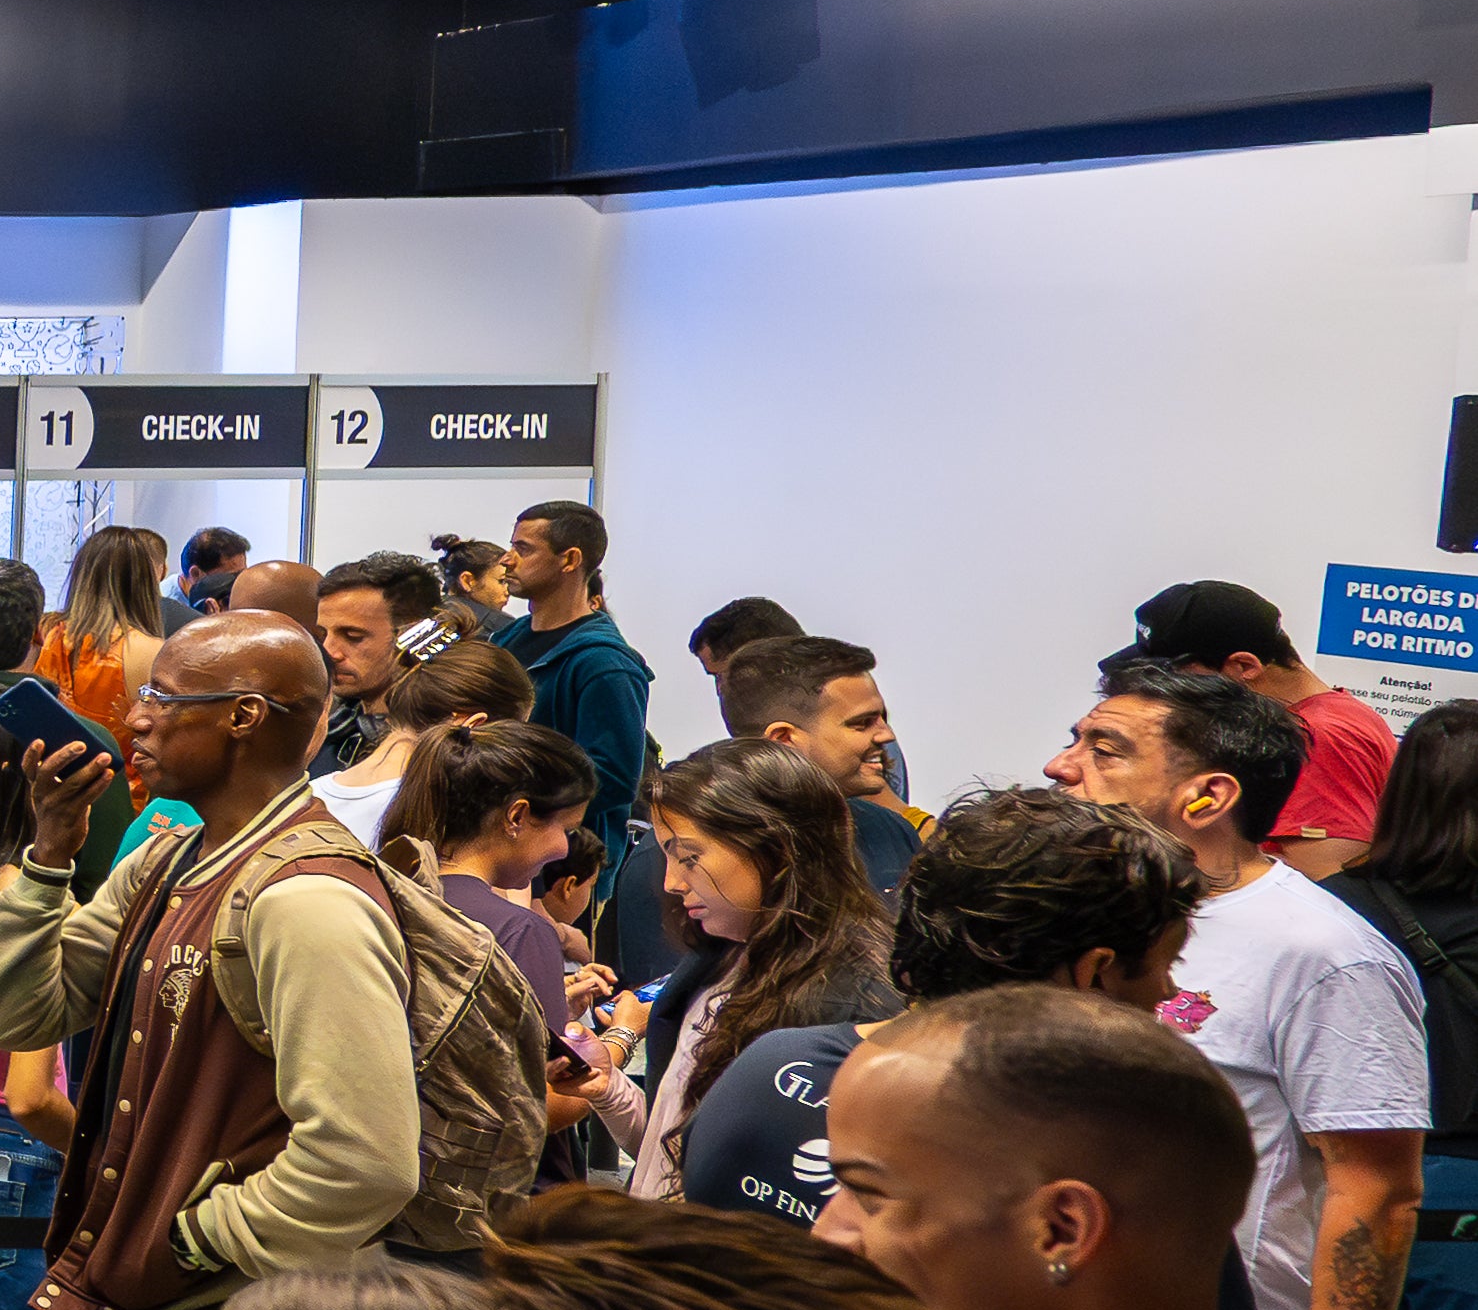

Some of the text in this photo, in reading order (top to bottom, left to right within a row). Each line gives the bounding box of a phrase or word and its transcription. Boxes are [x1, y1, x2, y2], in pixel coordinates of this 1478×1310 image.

[40, 410, 260, 446] 11 CHECK-IN
[330, 409, 548, 445] 12 CHECK-IN
[1346, 581, 1478, 609] PELOTÕES D
[1361, 607, 1465, 633] LARGADA
[1352, 629, 1474, 659] POR RITMO
[741, 1175, 818, 1224] OP FIN
